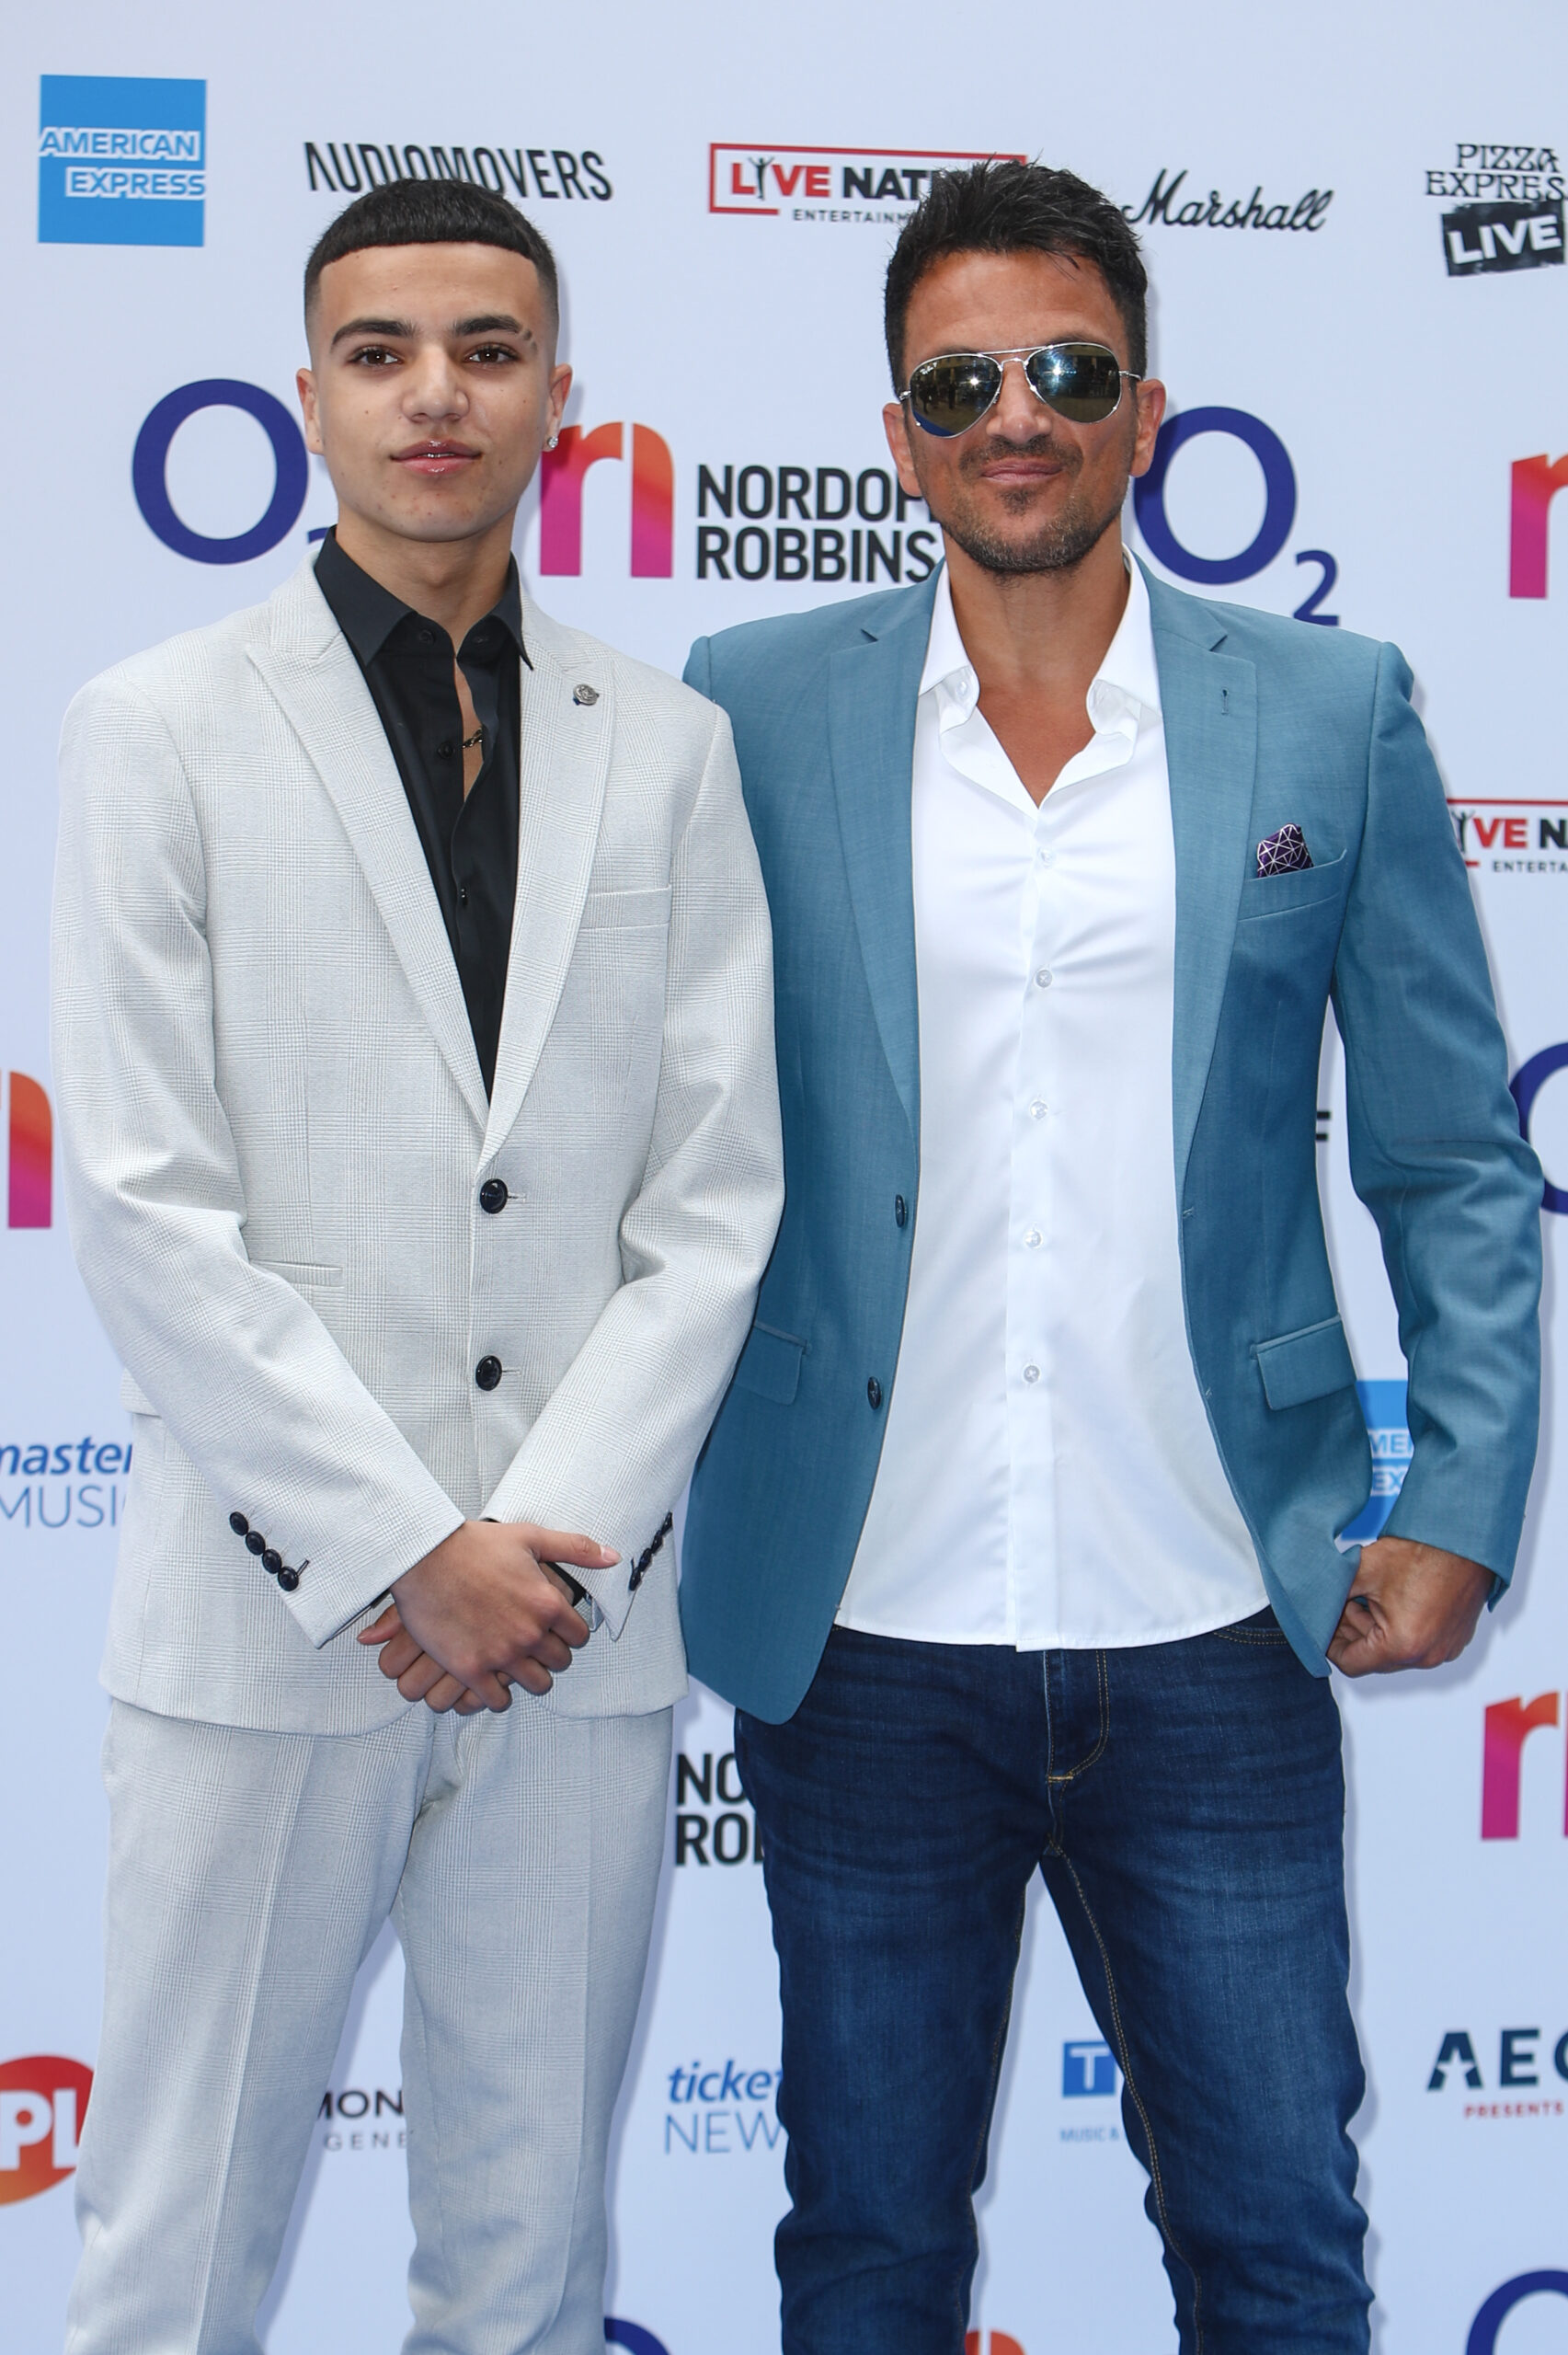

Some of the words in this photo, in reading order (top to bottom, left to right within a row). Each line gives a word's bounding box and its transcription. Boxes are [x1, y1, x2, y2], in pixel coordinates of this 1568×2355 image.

[40, 130, 196, 158] AMERICAN
[1456, 144, 1560, 173] PIZZA
[70, 171, 205, 195] EXPRESS
[1425, 170, 1568, 201] EXPRES
[1121, 168, 1333, 232] Marshall
[1448, 214, 1562, 264] LIVE
[697, 526, 937, 582] ROBBINS
[1465, 2101, 1563, 2119] PRESENTS
